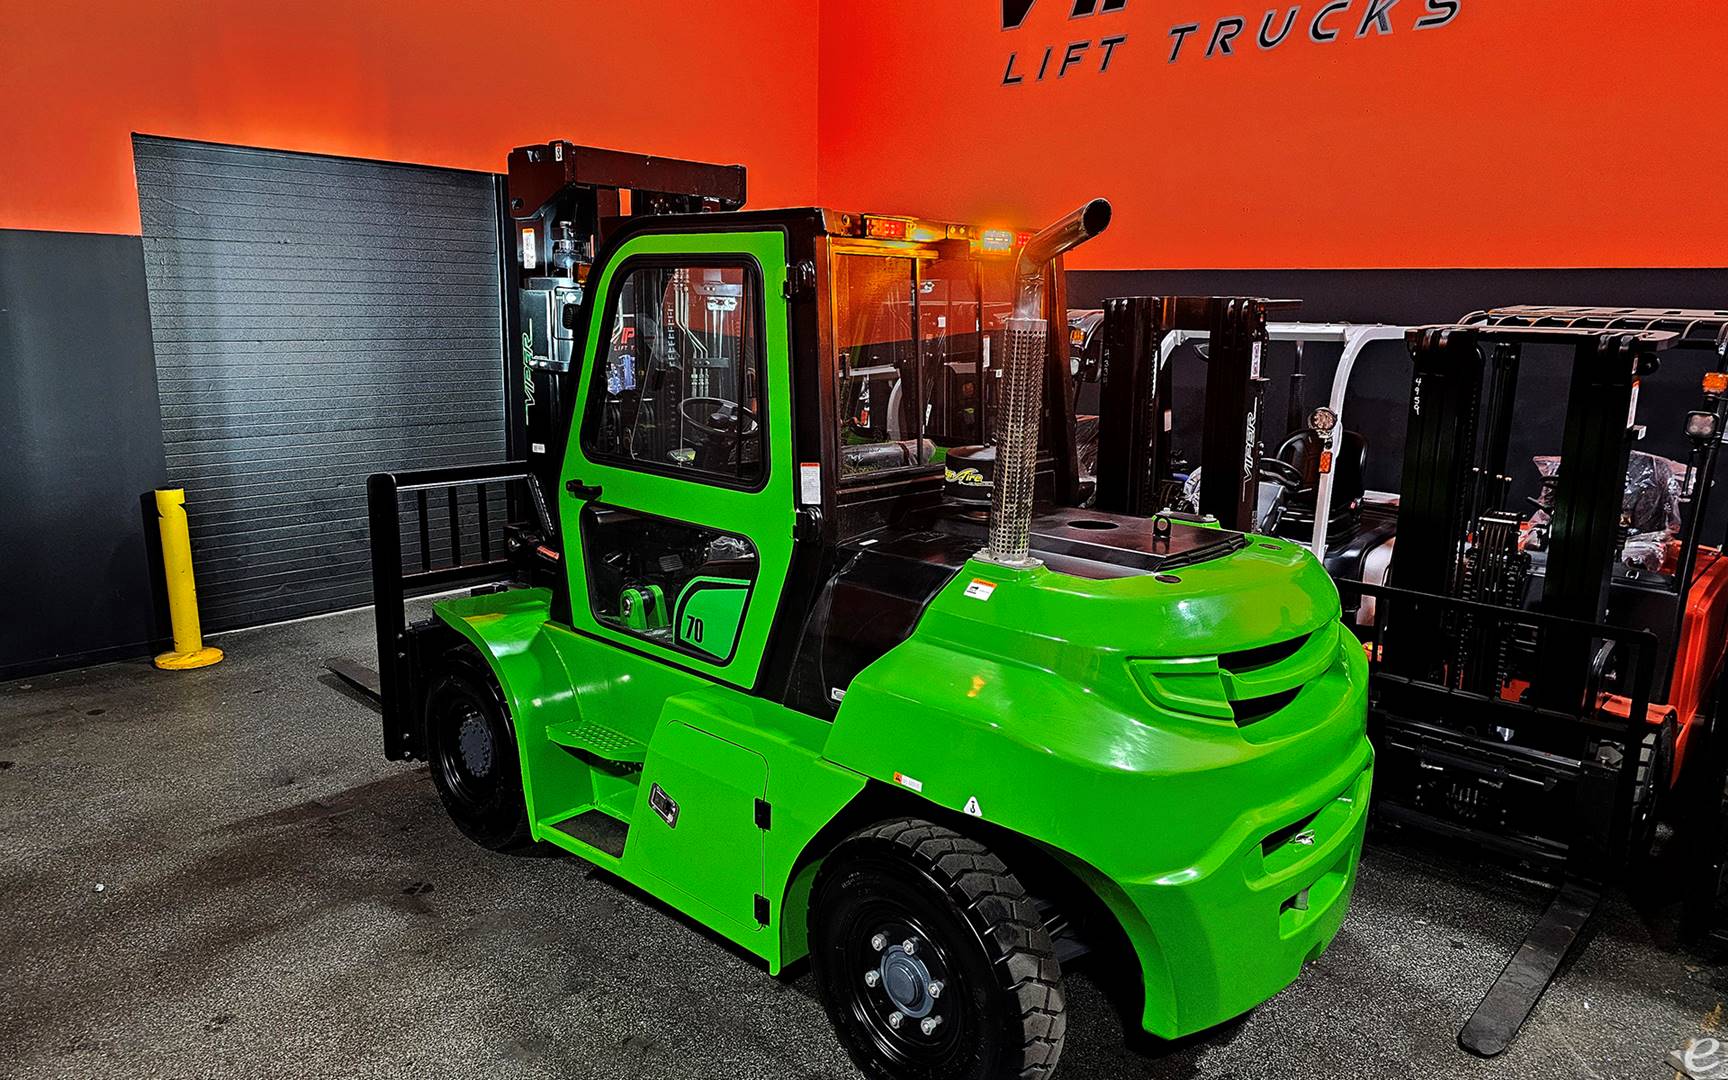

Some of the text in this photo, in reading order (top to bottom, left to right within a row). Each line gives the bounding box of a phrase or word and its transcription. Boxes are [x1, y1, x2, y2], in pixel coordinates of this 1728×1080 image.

[1002, 33, 1128, 87] LIFT
[1167, 0, 1461, 64] TRUCKS
[1241, 397, 1258, 502] VIPER
[684, 614, 705, 643] 70
